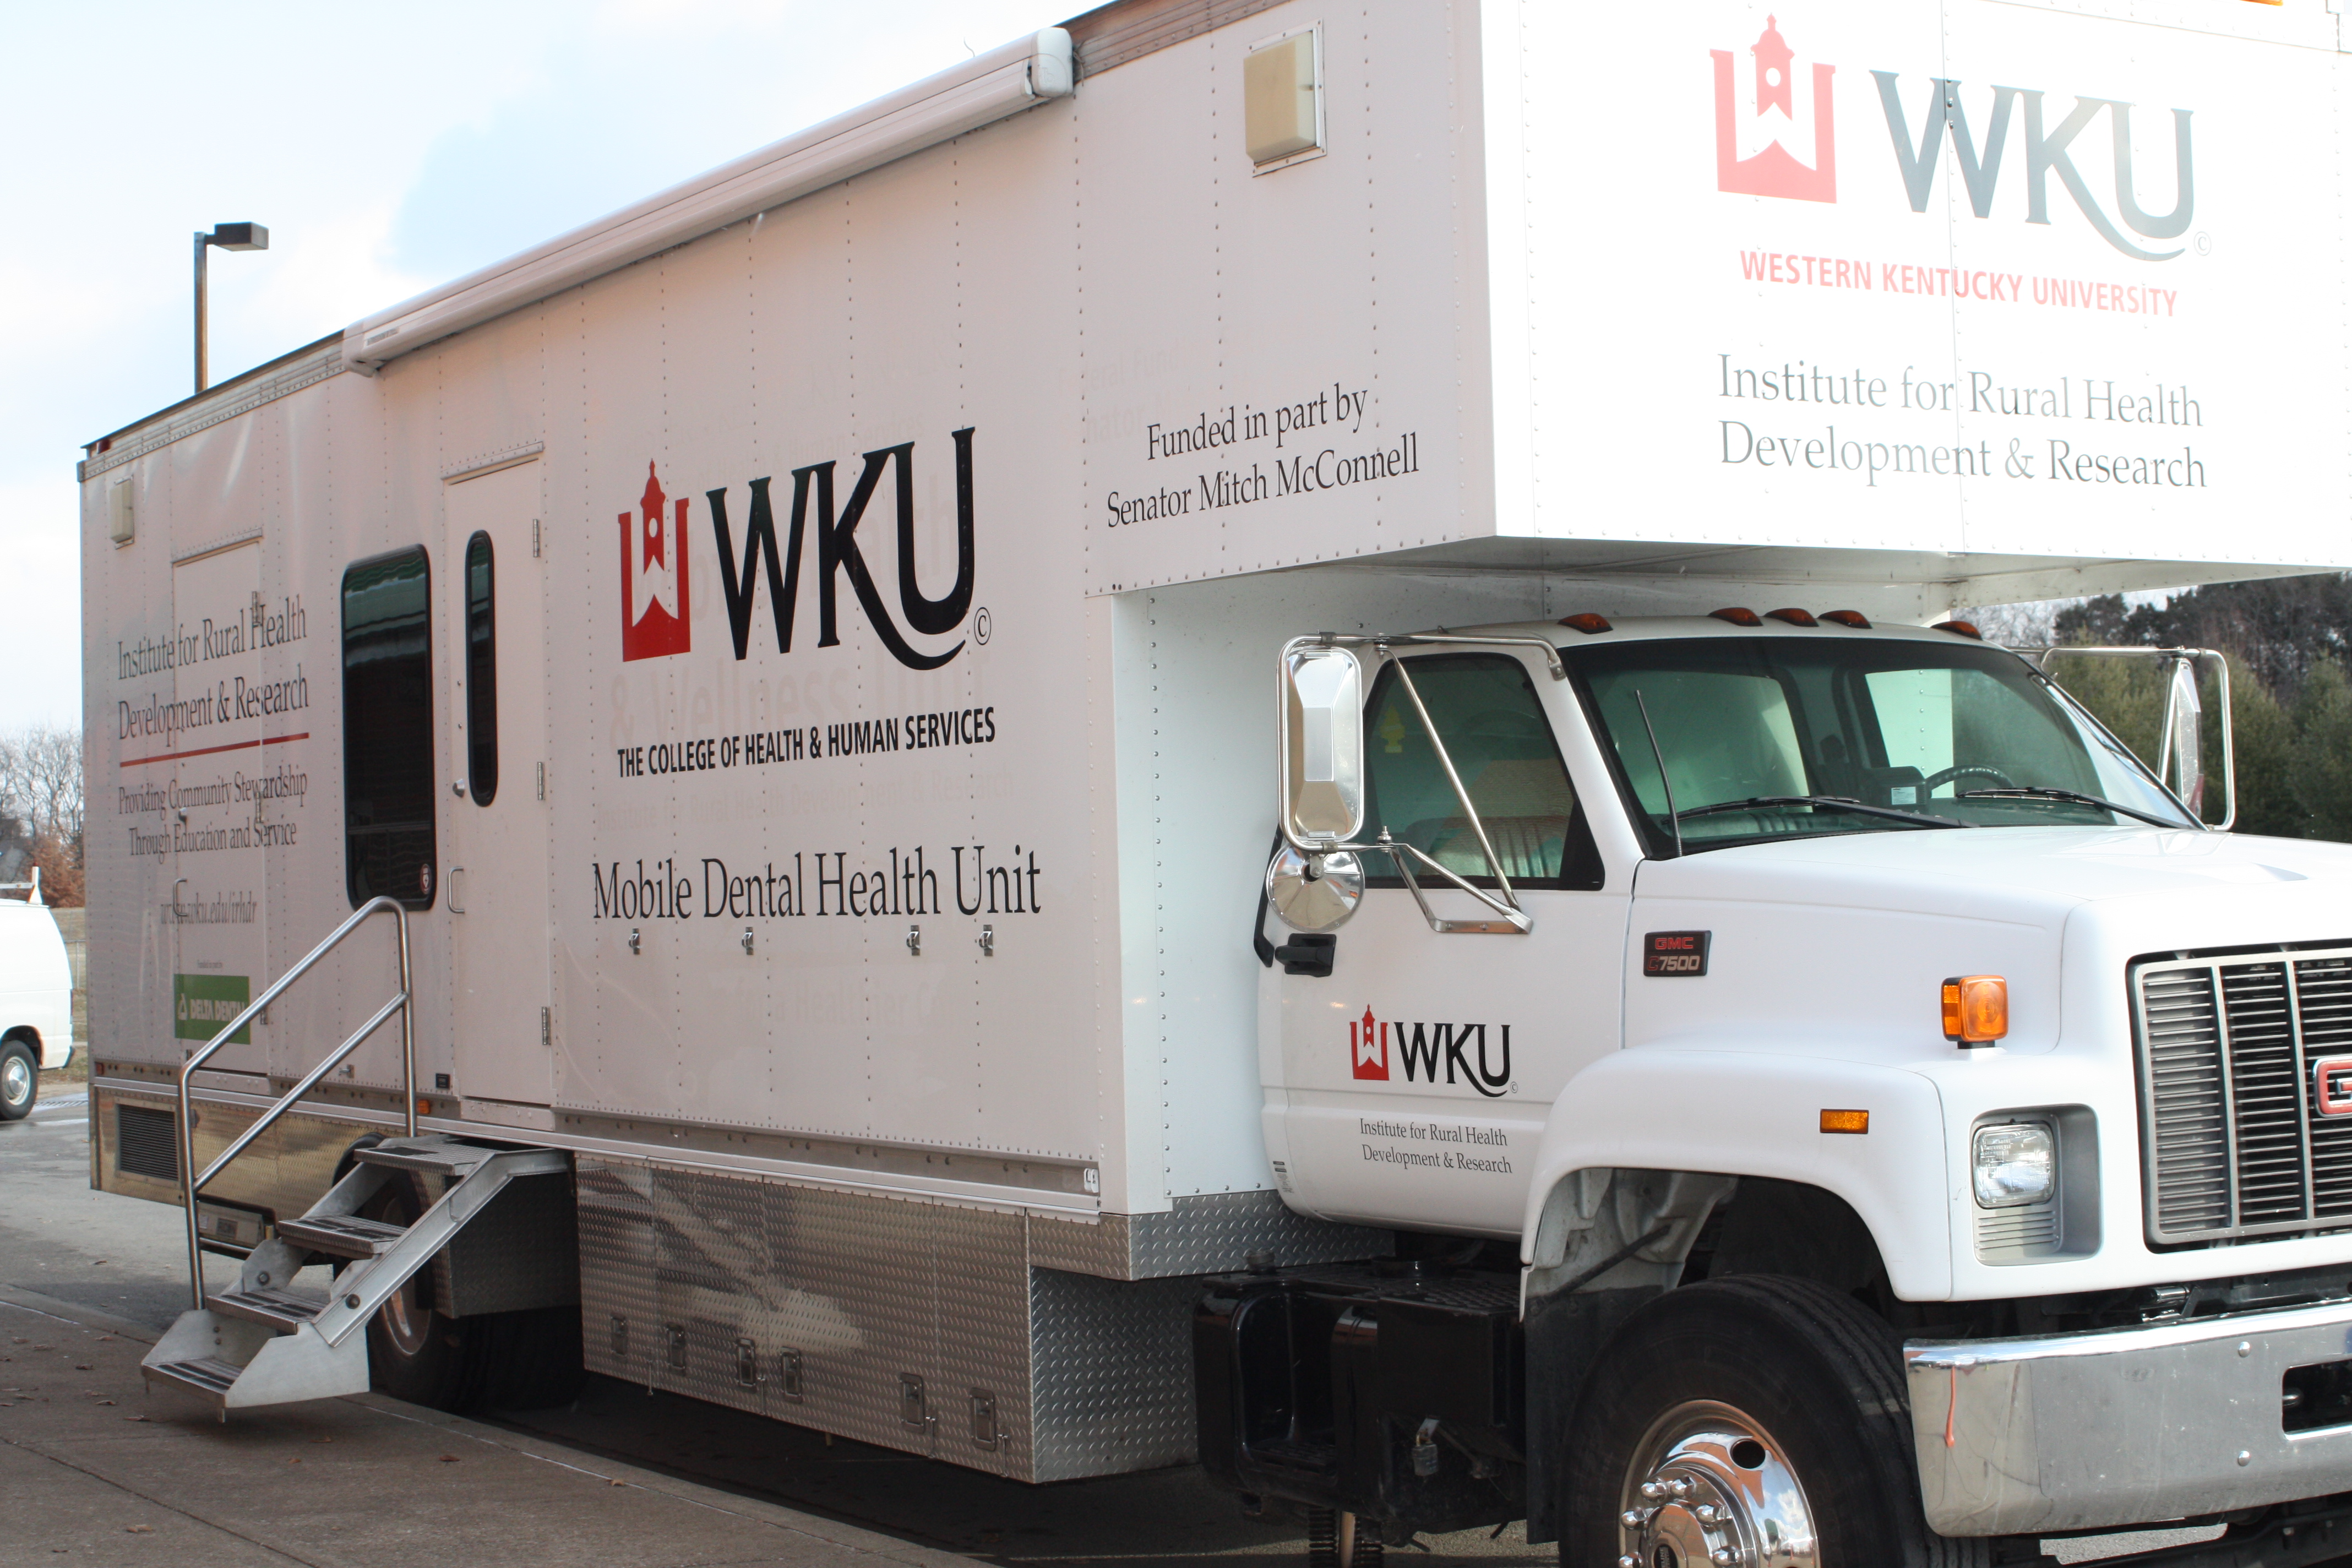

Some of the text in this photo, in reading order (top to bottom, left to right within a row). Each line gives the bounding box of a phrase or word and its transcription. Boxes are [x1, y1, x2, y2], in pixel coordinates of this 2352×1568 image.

[1869, 69, 2194, 262] WKU
[1740, 250, 2178, 317] WESTERN KENTUCKY UNIVERSITY
[1147, 407, 1237, 460] Funded
[1244, 404, 1268, 440] in
[1276, 391, 1327, 448] part
[1334, 383, 1368, 433] by
[1717, 353, 2203, 427] Institute for Rural Health
[1108, 432, 1419, 529] Senator Mitch McConnell
[1718, 421, 2208, 488] Development & Research
[706, 426, 976, 671] WKU
[118, 594, 307, 680] Institute for Rural Health
[118, 663, 309, 747] Development & Research
[618, 706, 996, 778] THE COLLEGE OF HEALTH & HUMAN SERVICES
[118, 764, 308, 820] Providing Community Stewardship
[129, 814, 297, 864] Through Education and Service
[592, 845, 1042, 920] Mobile Dental Health Unit
[1647, 955, 1701, 971] C7500
[1655, 937, 1694, 950] GMC
[190, 999, 214, 1020] DELTA
[1393, 1022, 1511, 1098] WKU
[1360, 1118, 1508, 1146] Institute for Rural Health
[1362, 1144, 1513, 1173] Development & Research
